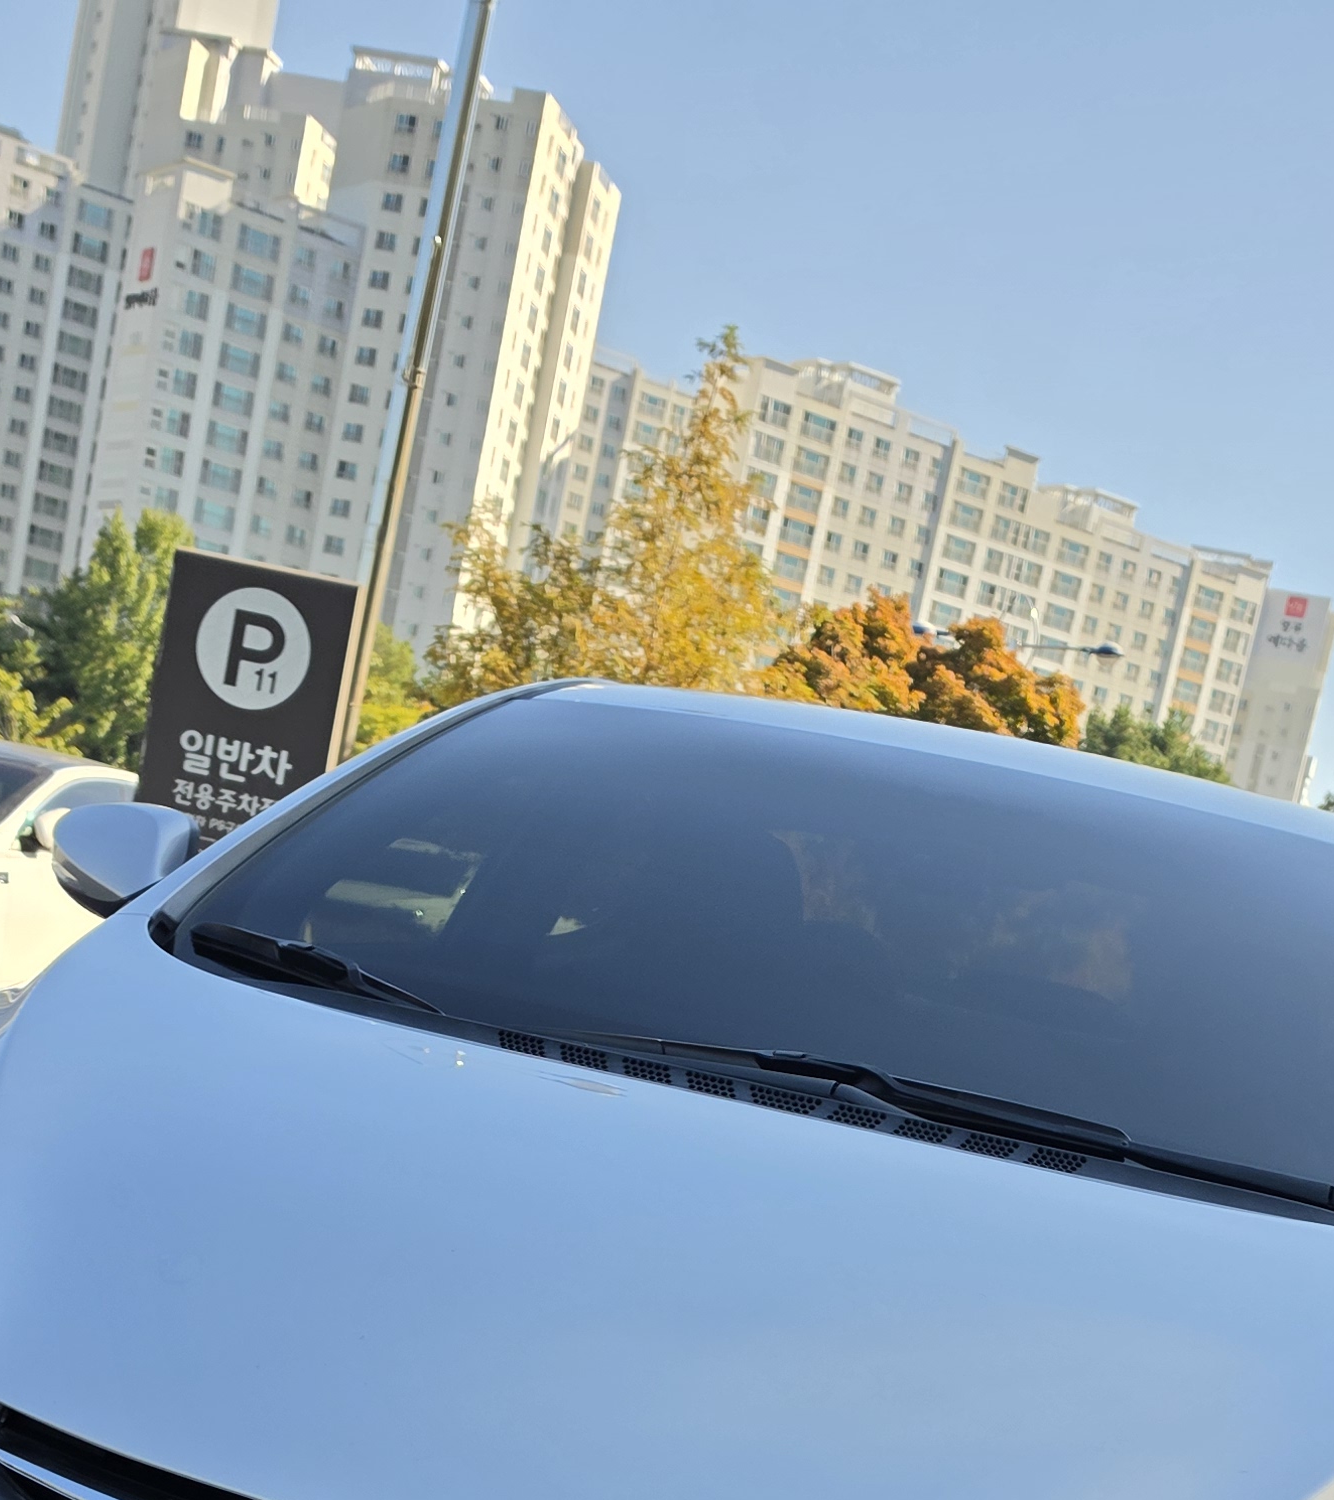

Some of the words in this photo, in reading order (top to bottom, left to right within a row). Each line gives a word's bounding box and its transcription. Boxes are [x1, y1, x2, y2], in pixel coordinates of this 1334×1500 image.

[223, 608, 286, 687] P
[254, 668, 279, 694] 11
[179, 729, 293, 785] 일반차
